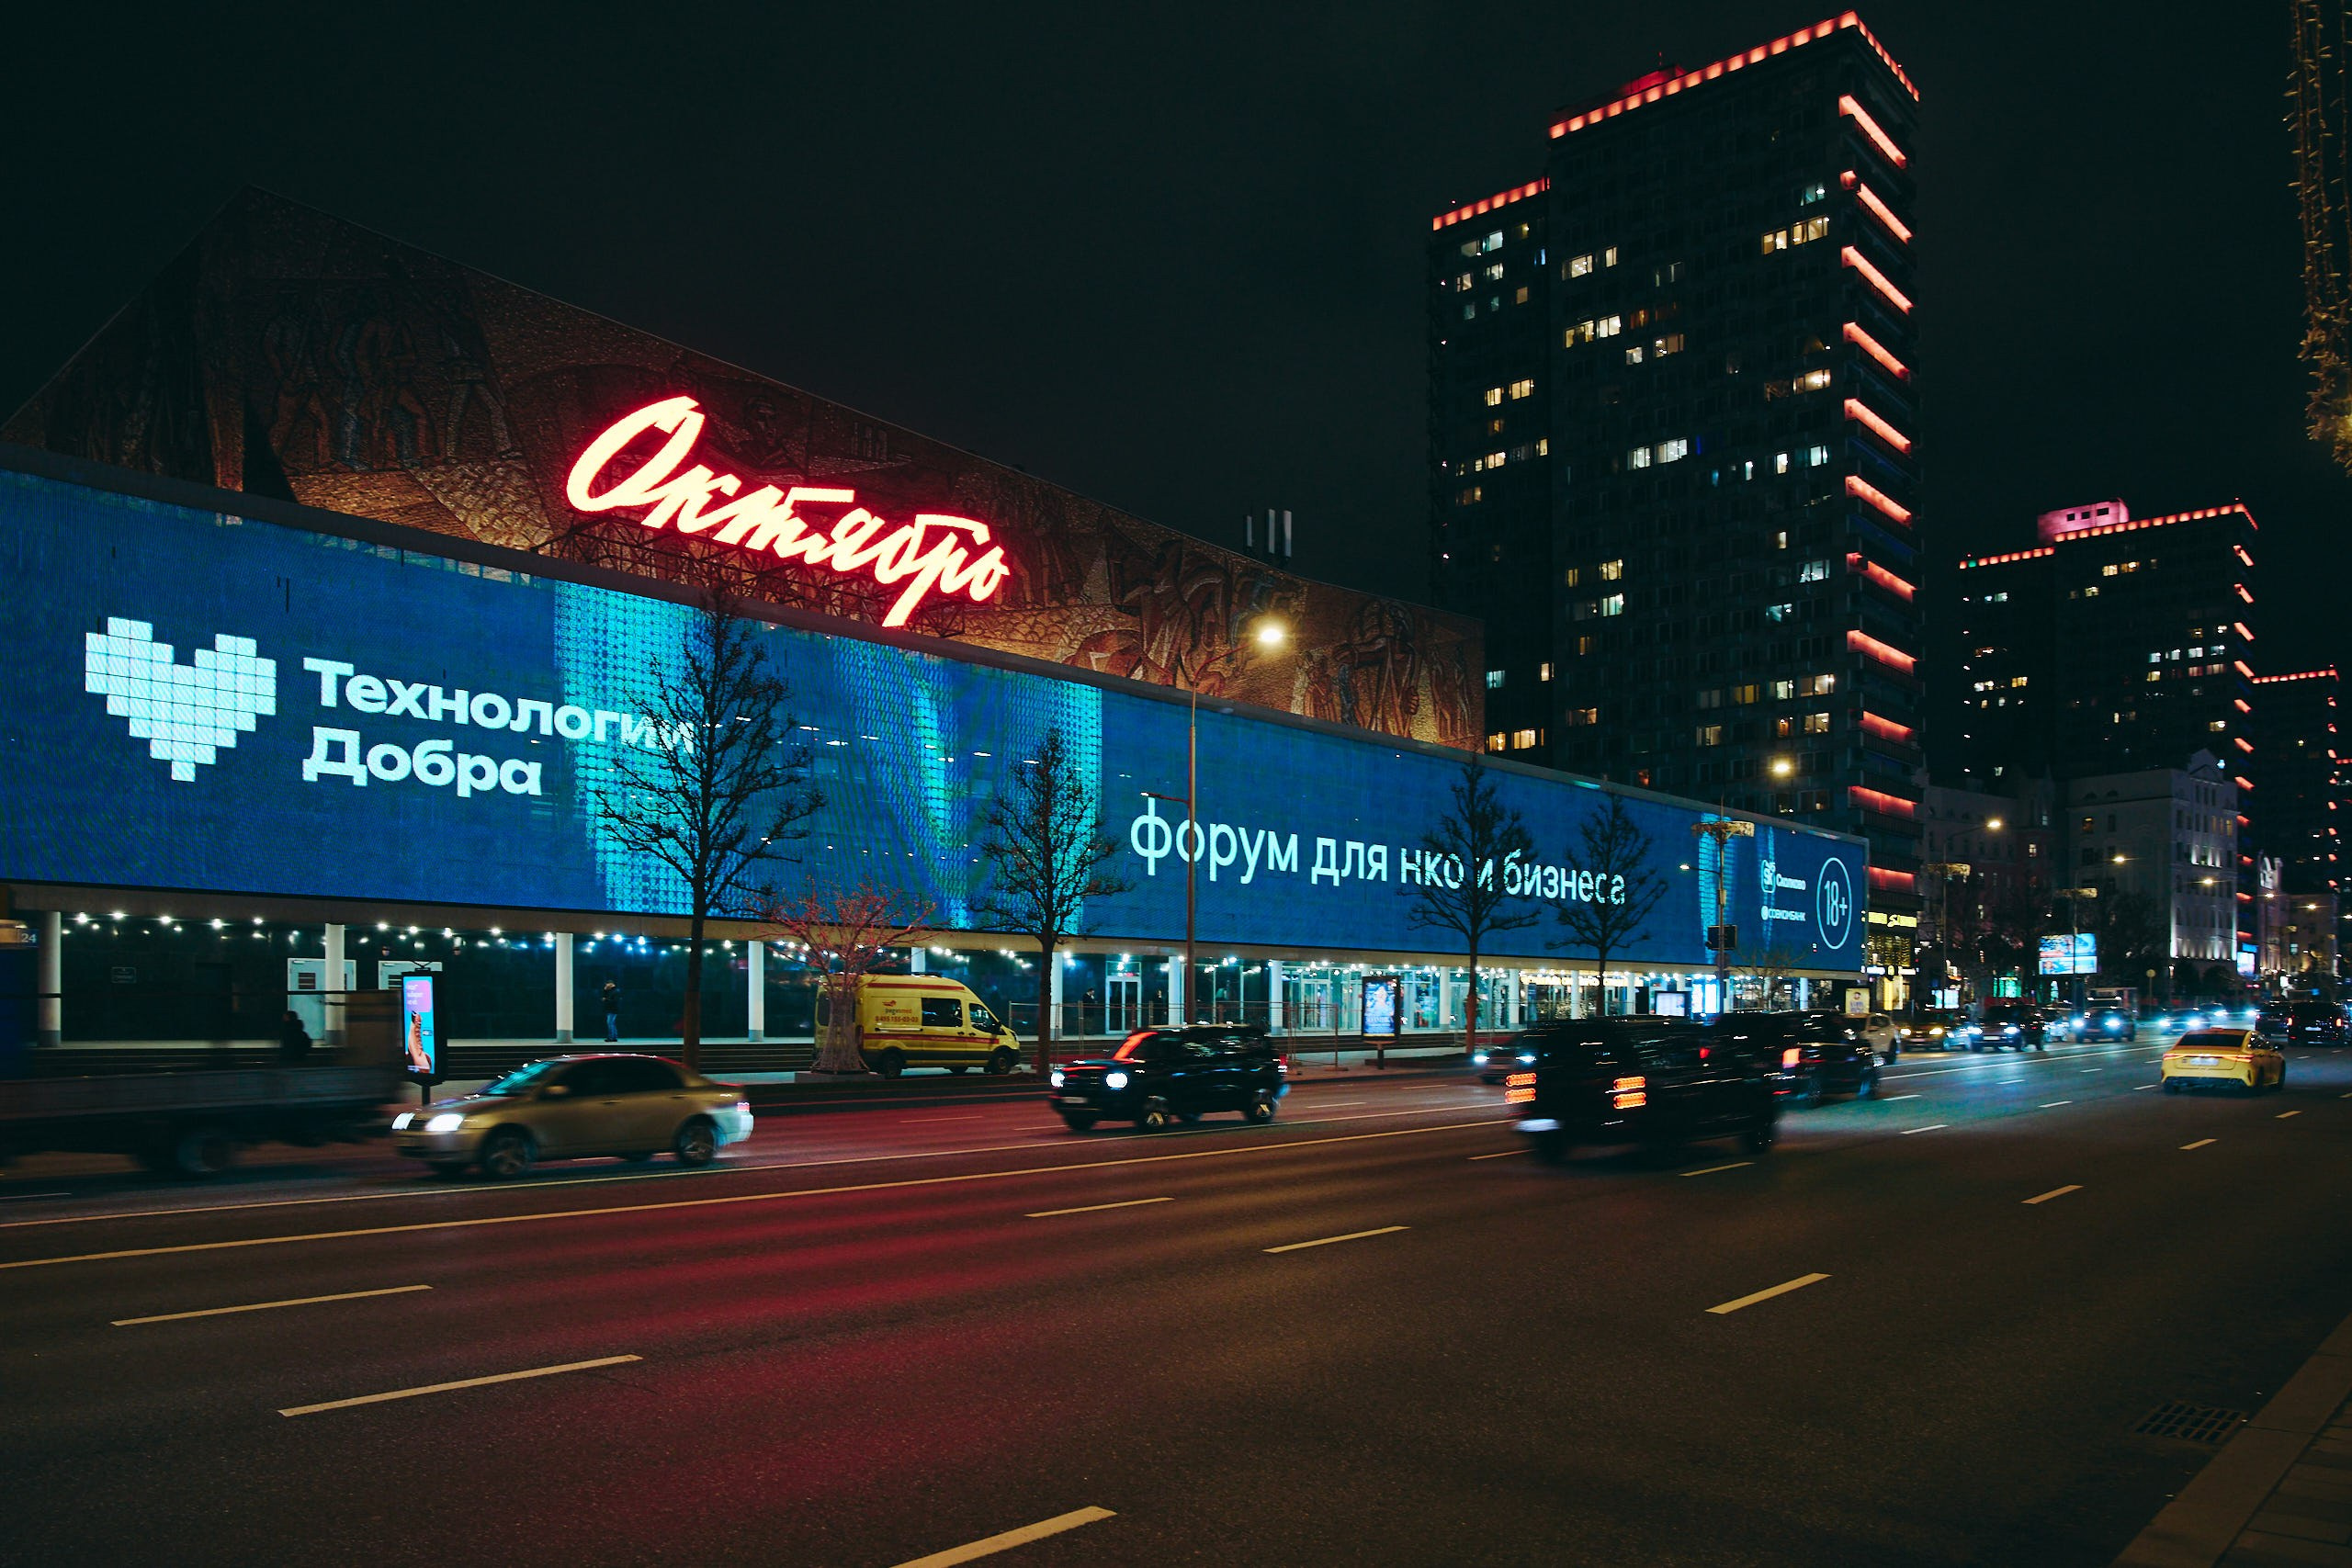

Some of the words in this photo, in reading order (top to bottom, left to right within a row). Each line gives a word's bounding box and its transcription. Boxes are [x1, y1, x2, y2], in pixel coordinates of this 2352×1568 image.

[566, 395, 1011, 627] Октябрь
[302, 657, 695, 754] Технологии
[302, 726, 542, 797] Добра
[1130, 796, 1299, 885] форум
[1311, 837, 1388, 887] для
[1400, 847, 1464, 890] нко
[1504, 849, 1625, 906] бизнеса
[21, 932, 37, 943] 24
[1824, 880, 1848, 927] 18+
